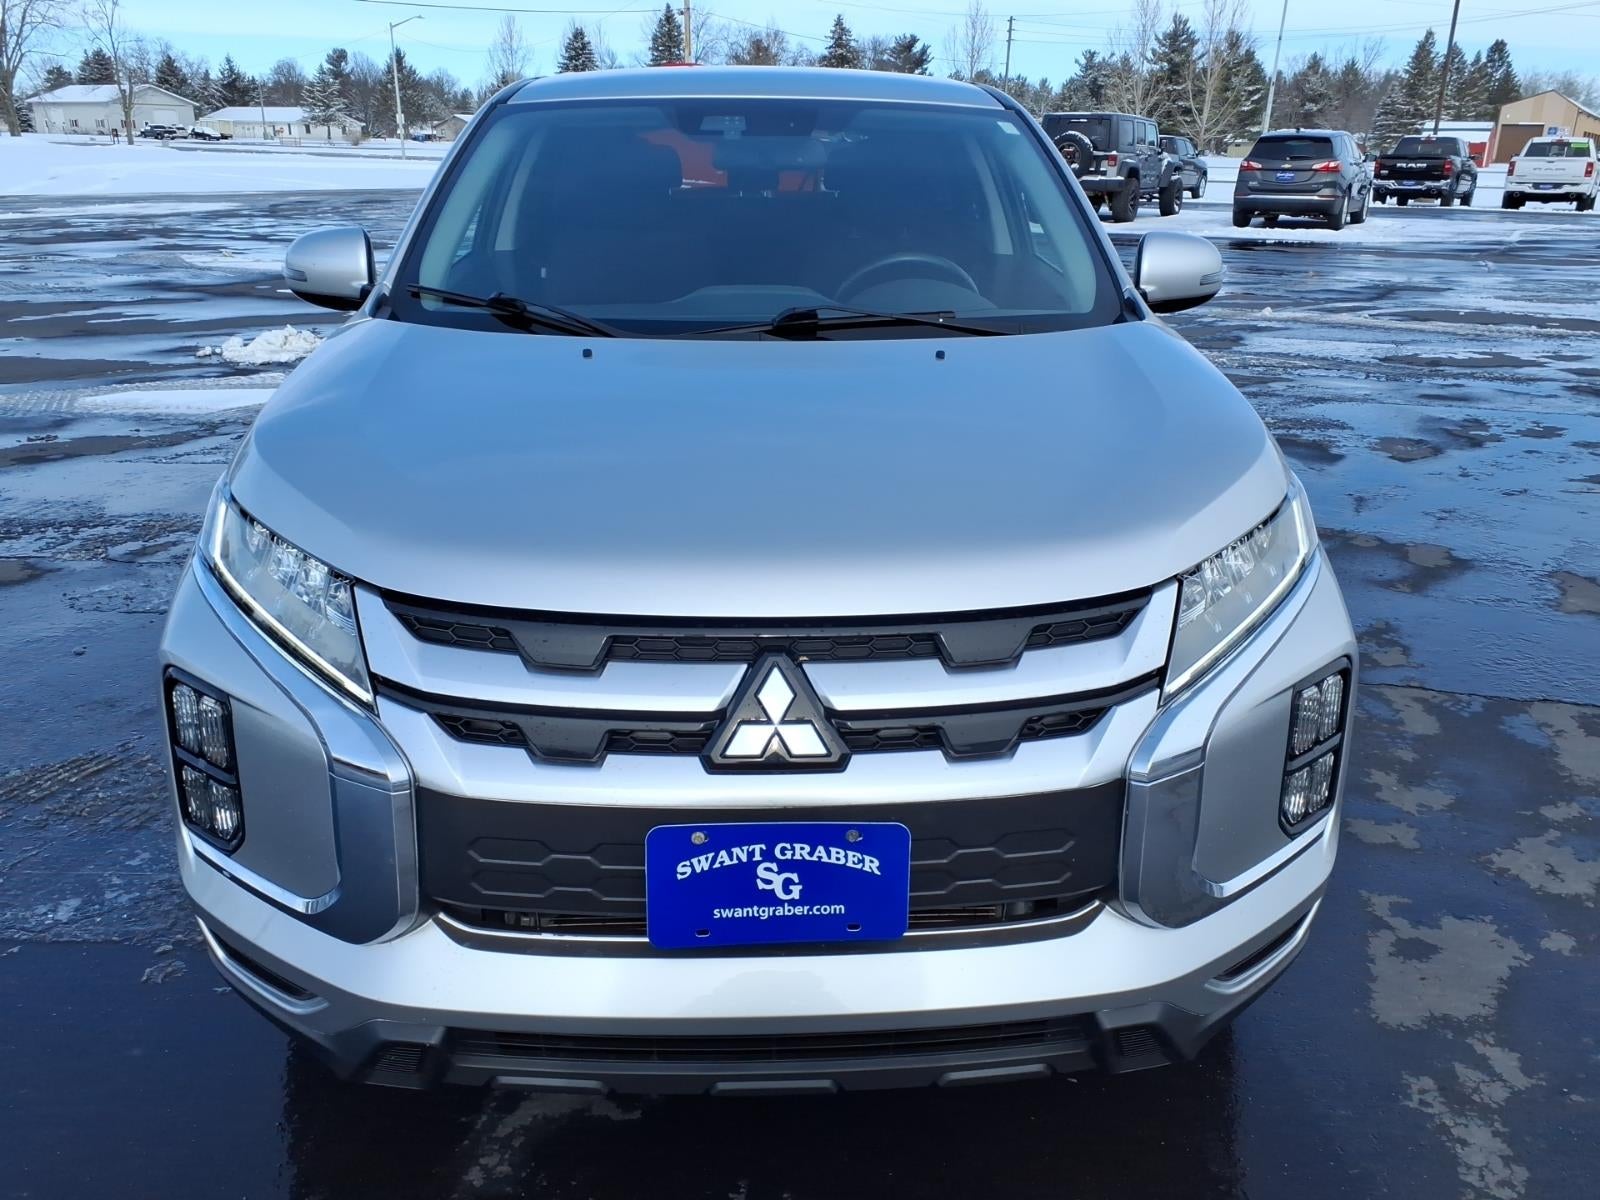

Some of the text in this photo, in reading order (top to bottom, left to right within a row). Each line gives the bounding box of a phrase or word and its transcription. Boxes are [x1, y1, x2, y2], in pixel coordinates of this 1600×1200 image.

[676, 842, 881, 880] SWANT GRABER
[756, 862, 802, 900] SG
[713, 903, 845, 920] swantgraber.com
